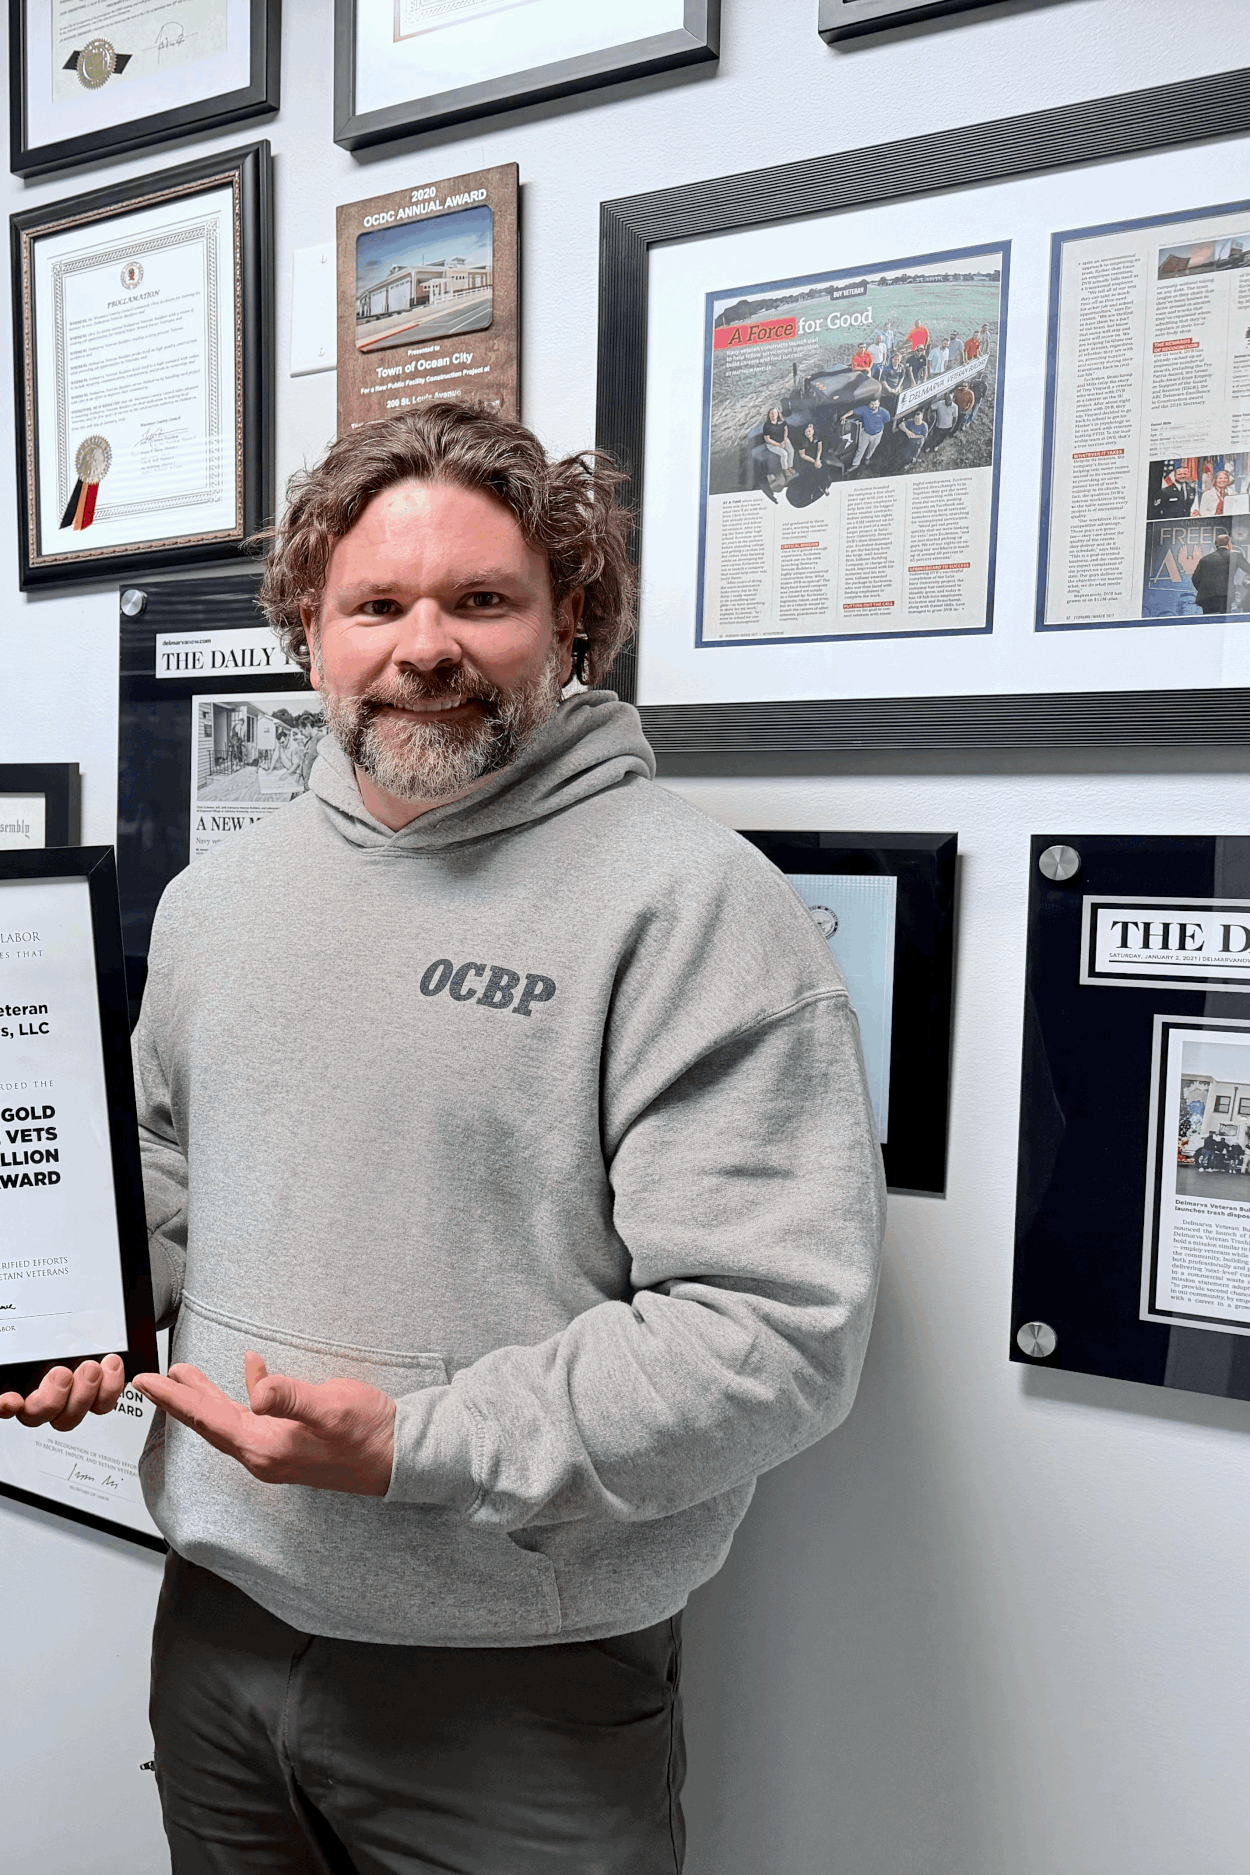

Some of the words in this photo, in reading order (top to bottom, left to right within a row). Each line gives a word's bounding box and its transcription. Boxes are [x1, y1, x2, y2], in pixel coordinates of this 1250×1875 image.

[411, 186, 436, 202] 2020
[364, 211, 395, 227] OCDC
[397, 200, 443, 220] ANNUAL
[445, 189, 487, 208] AWARD
[107, 290, 160, 308] PROCLAMATION
[728, 328, 742, 345] A
[747, 323, 794, 342] Force
[797, 317, 823, 334] for
[827, 307, 873, 329] Good
[408, 346, 433, 356] Presented
[376, 366, 402, 378] Town
[405, 361, 415, 373] of
[417, 356, 450, 370] Ocean
[452, 352, 473, 364] City
[360, 387, 370, 395] For
[375, 384, 387, 392] New
[388, 381, 404, 390] Public
[406, 377, 425, 387] Facility
[426, 371, 462, 383] Construction
[463, 368, 483, 376] Project
[386, 398, 400, 408] 200
[401, 396, 411, 406] St.
[162, 651, 204, 671] THE
[211, 647, 276, 669] DAILY
[196, 816, 207, 830] A
[211, 816, 245, 831] NEW
[196, 837, 210, 845] Navy
[0, 931, 41, 943] LABOR
[1110, 921, 1205, 951] THE
[1218, 924, 1250, 953] D
[16, 950, 44, 958] THAT
[419, 958, 556, 1017] OCBP
[18, 1022, 50, 1036] LLC
[34, 1080, 54, 1088] THE
[1, 1105, 56, 1122] GOLD
[5, 1127, 58, 1144] VETS
[1175, 1199, 1208, 1208] Delmarva
[1210, 1203, 1237, 1211] Veteran
[1175, 1206, 1205, 1214] launches
[1183, 1220, 1212, 1228] Delmarva
[1215, 1223, 1239, 1231] Veteran
[1173, 1231, 1203, 1239] Delmarva
[1205, 1235, 1229, 1243] Veteran
[1193, 1240, 1217, 1248] mission
[33, 1256, 68, 1267] EFFORTS
[26, 1267, 69, 1278] VETERANS
[114, 1403, 143, 1418] ARD
[55, 1440, 89, 1455] RECOGNITION
[122, 1461, 137, 1470] EFFOR
[117, 1467, 138, 1477] VETERA
